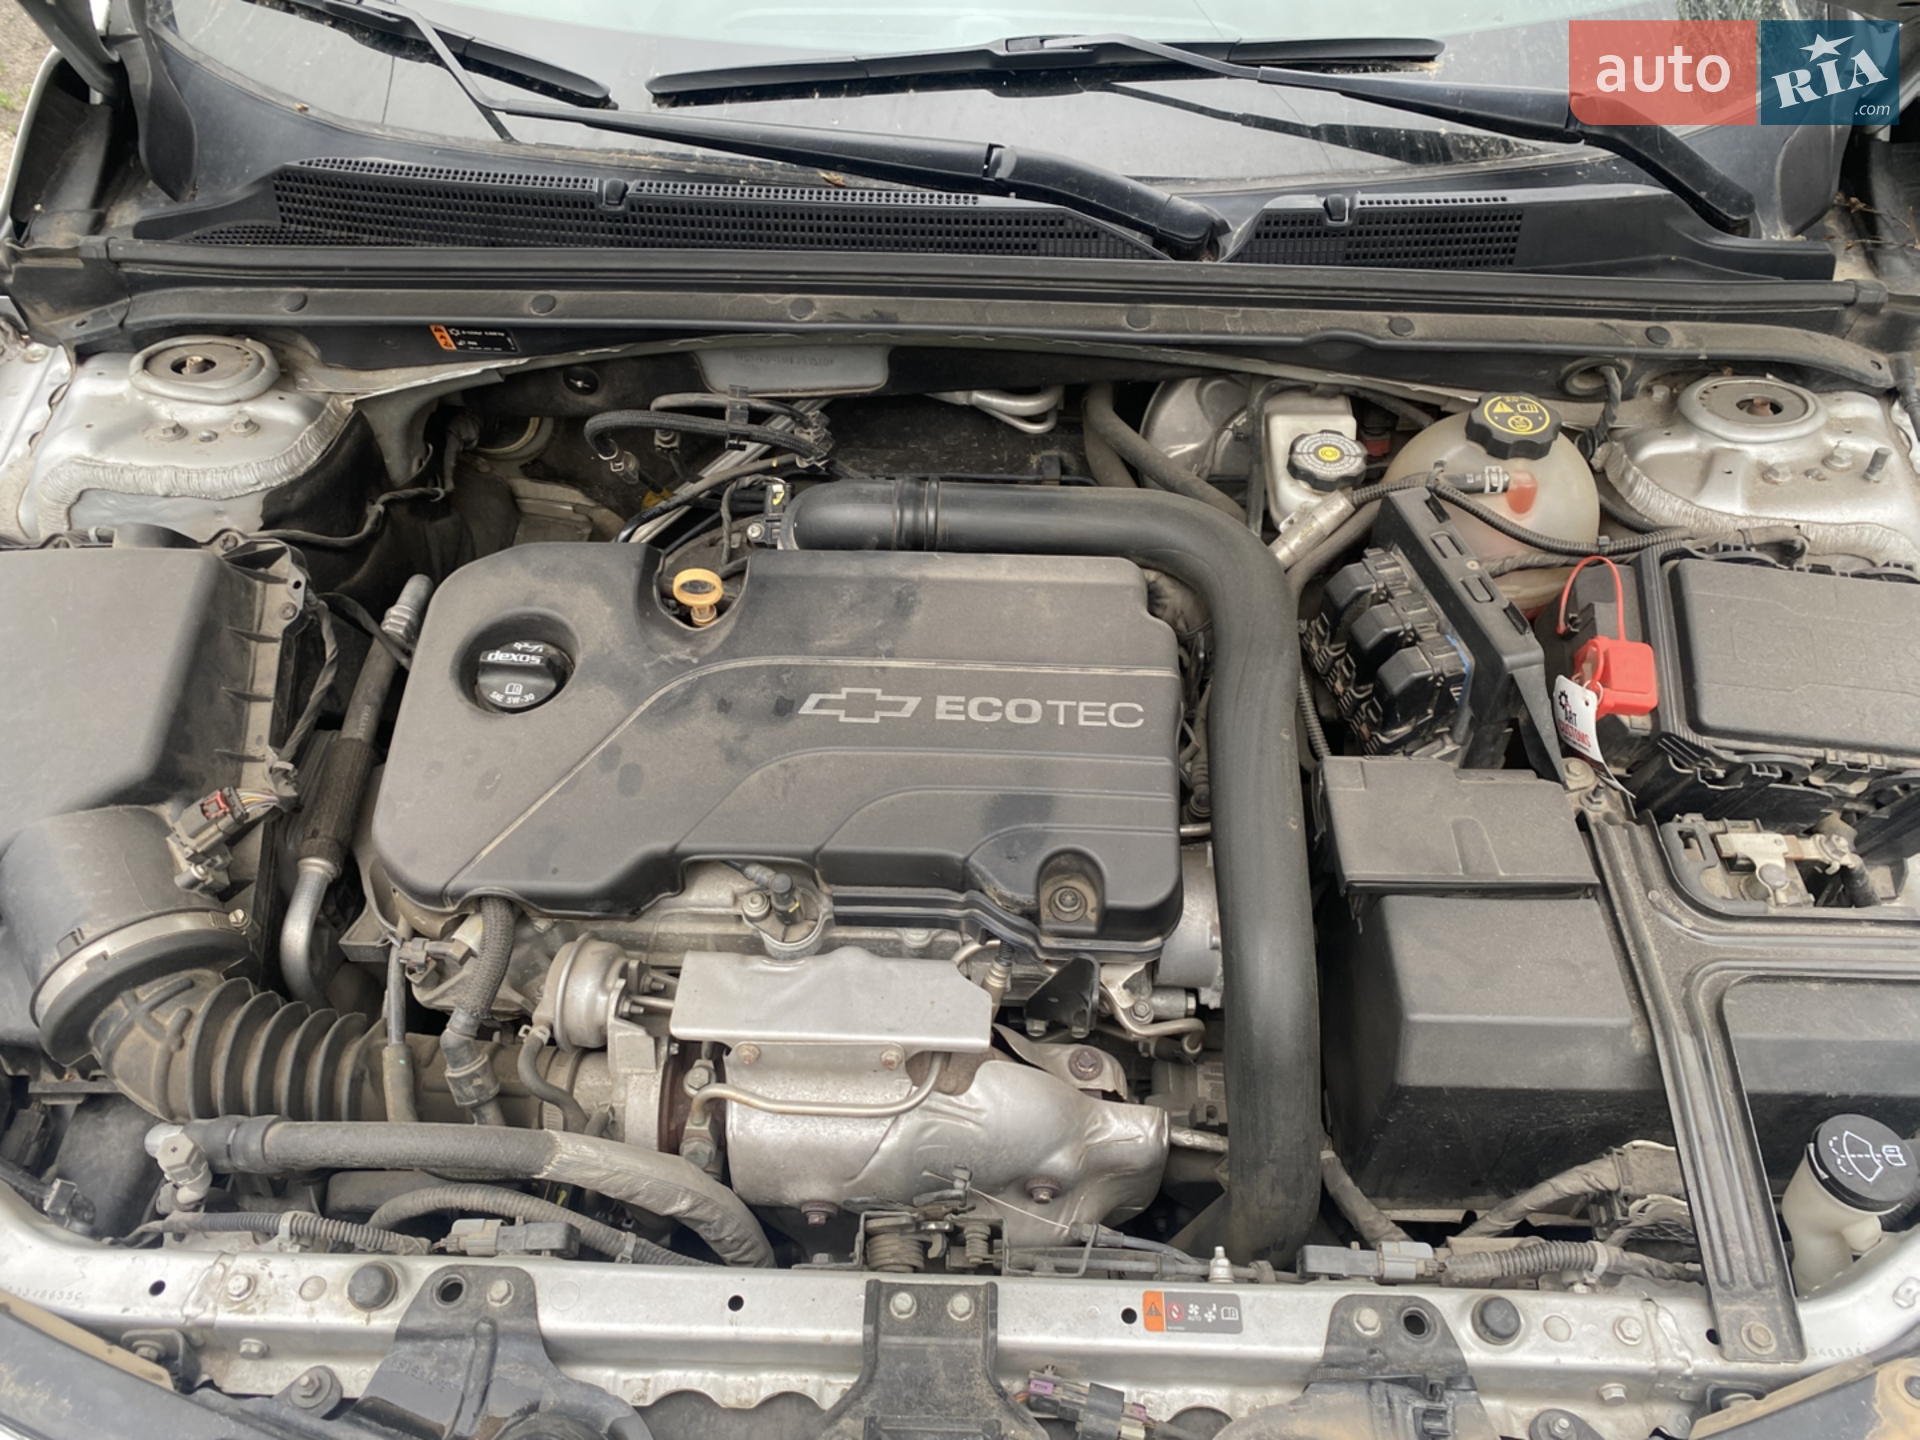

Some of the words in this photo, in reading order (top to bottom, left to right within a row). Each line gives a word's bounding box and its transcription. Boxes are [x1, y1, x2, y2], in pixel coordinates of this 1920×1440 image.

[487, 650, 542, 665] dexos
[506, 693, 535, 705] 5W-30
[935, 695, 1145, 728] ECOTEC
